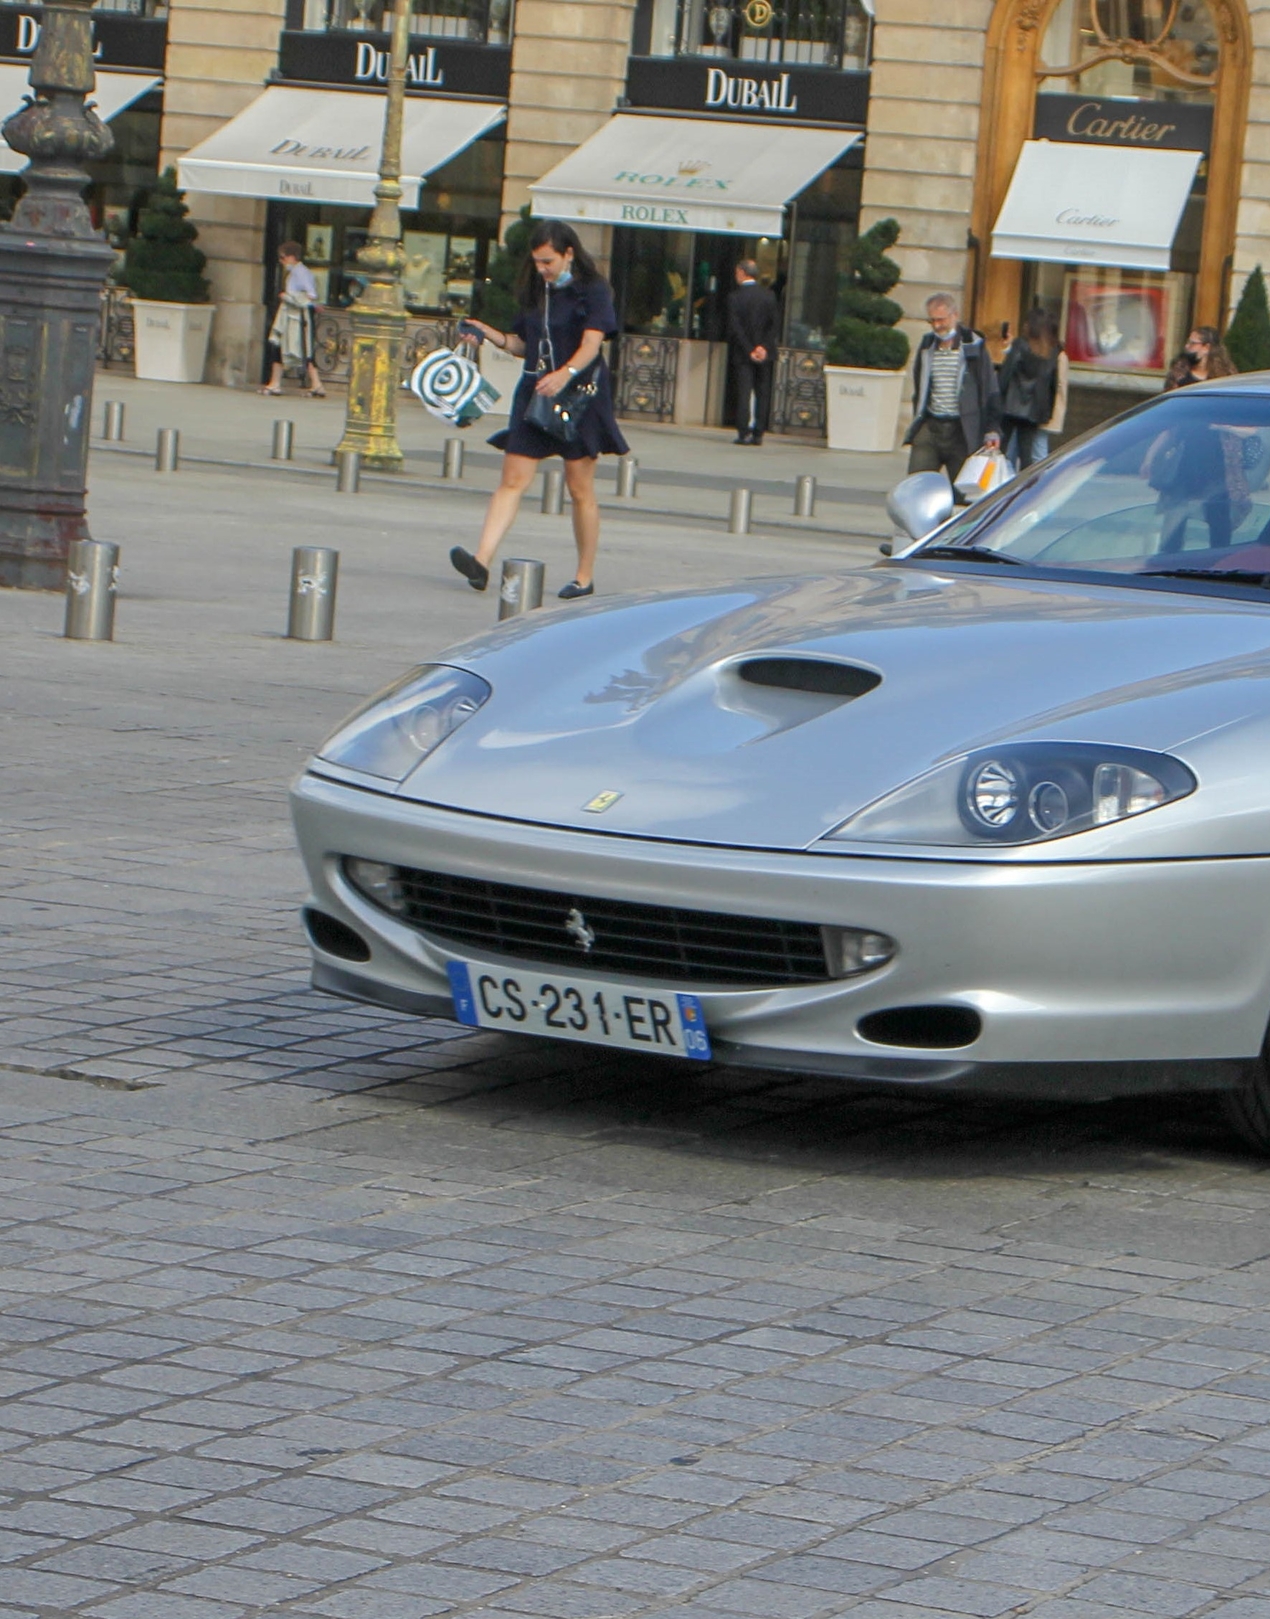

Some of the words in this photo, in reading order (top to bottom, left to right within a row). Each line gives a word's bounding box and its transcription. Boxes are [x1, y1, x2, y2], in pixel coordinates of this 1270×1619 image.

[355, 42, 443, 85] DUAIL
[1066, 102, 1176, 142] Cartier
[613, 171, 733, 190] ROLEX
[621, 204, 688, 224] ROLEX
[1056, 207, 1120, 227] Cartier
[479, 974, 677, 1046] CS-231-ER
[684, 1027, 706, 1052] 06
